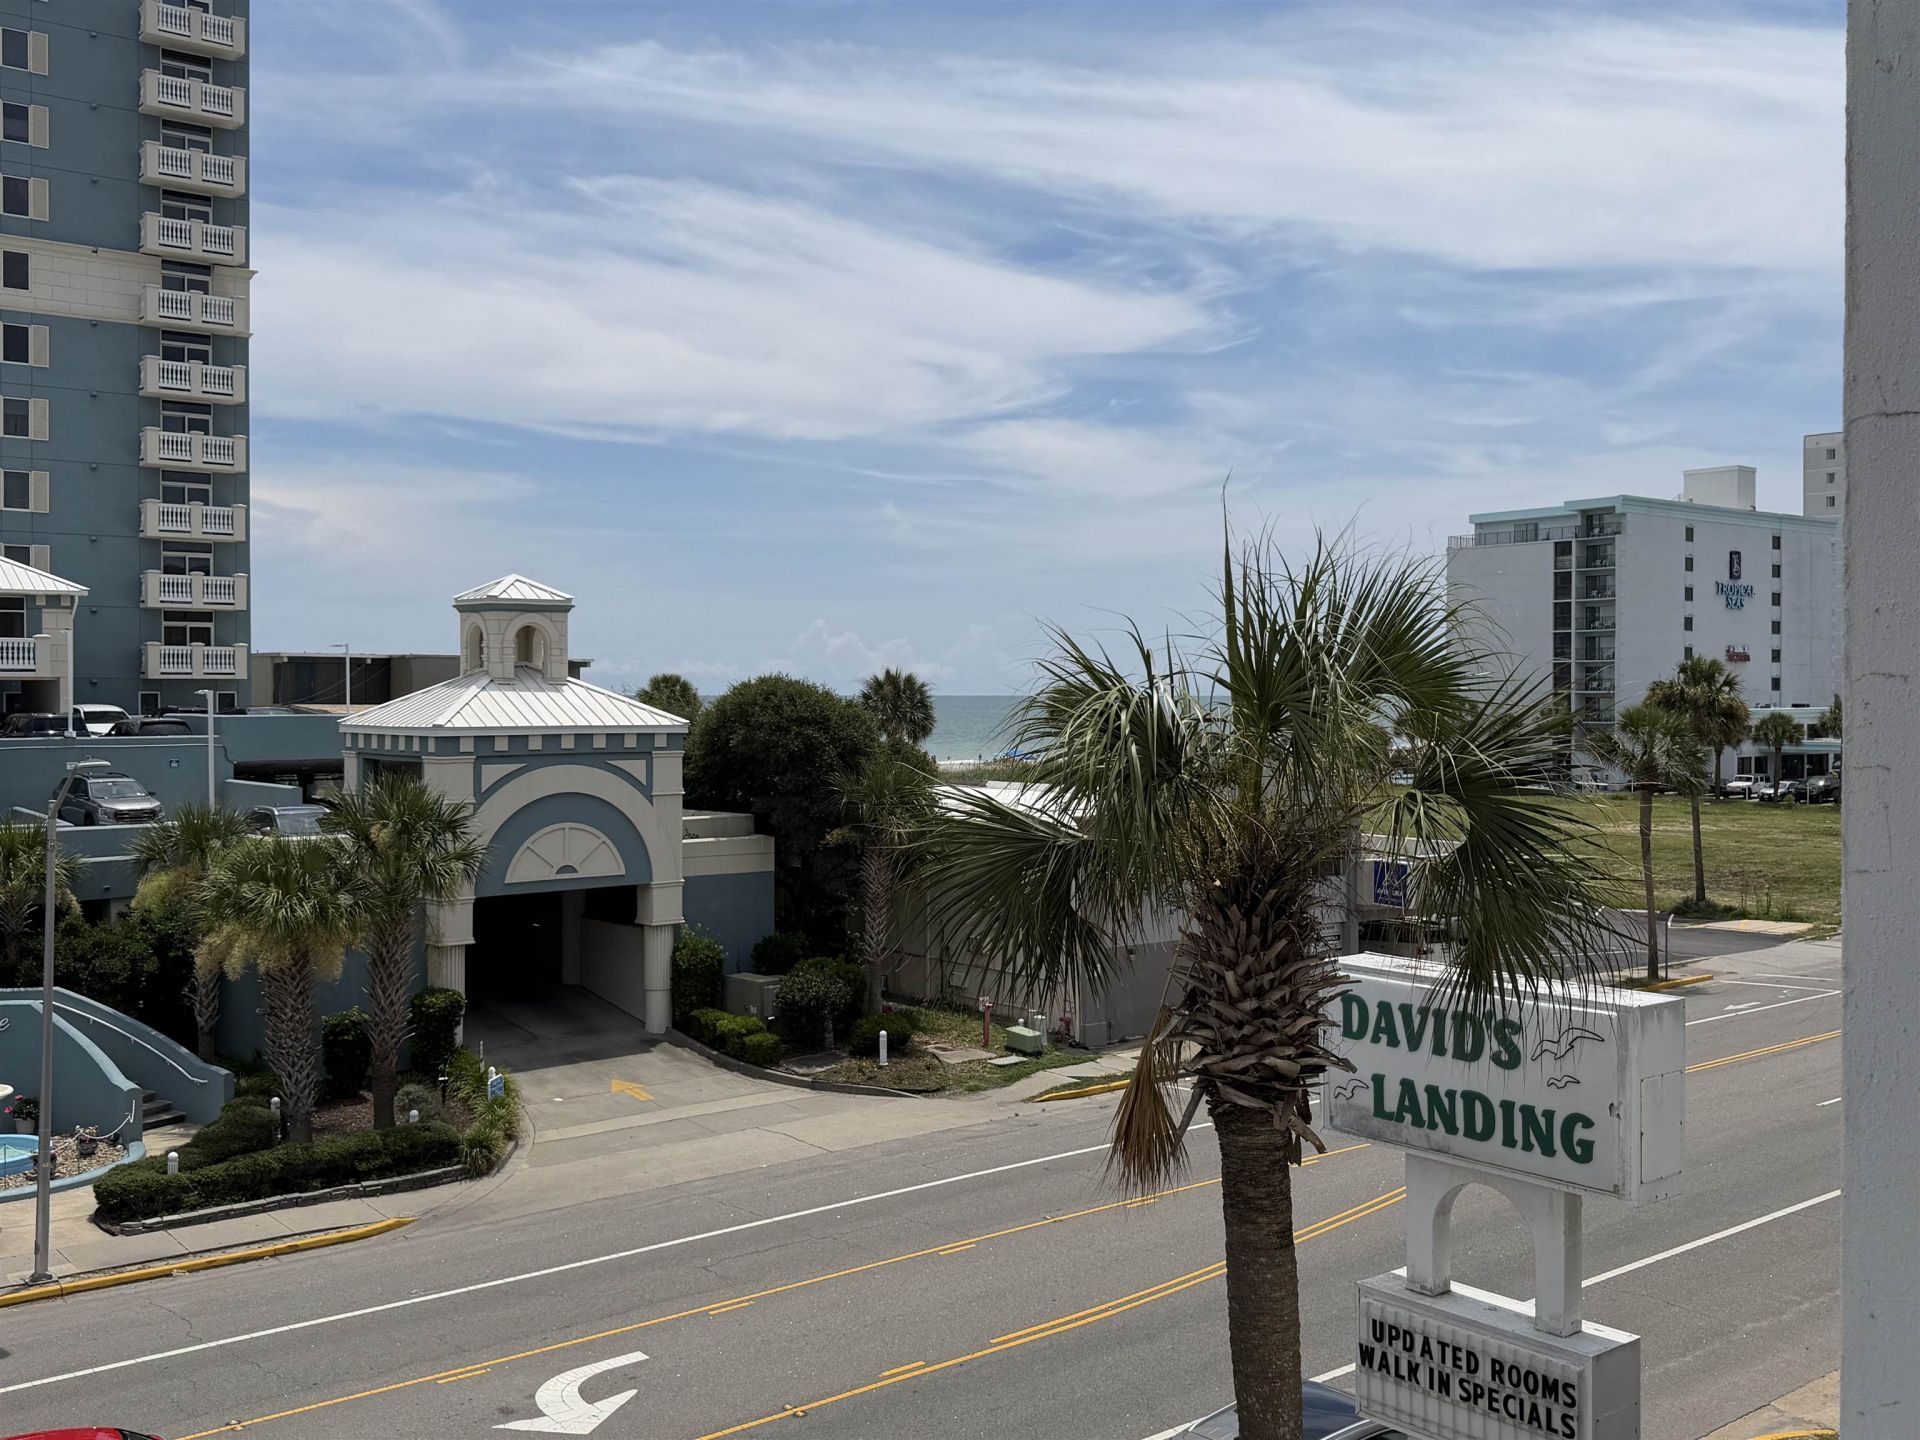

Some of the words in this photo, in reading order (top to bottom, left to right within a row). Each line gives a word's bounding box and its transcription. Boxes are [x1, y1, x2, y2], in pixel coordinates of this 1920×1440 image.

[1715, 582, 1756, 597] TROPICAL
[1340, 992, 1522, 1071] DAVID'S
[1371, 1073, 1596, 1165] LANDING
[1359, 1343, 1421, 1386] WALK
[1428, 1367, 1451, 1397] IN
[1458, 1378, 1577, 1440] SPECIALS
[1371, 1319, 1480, 1375] UPDATED
[1490, 1357, 1577, 1409] ROOMS
